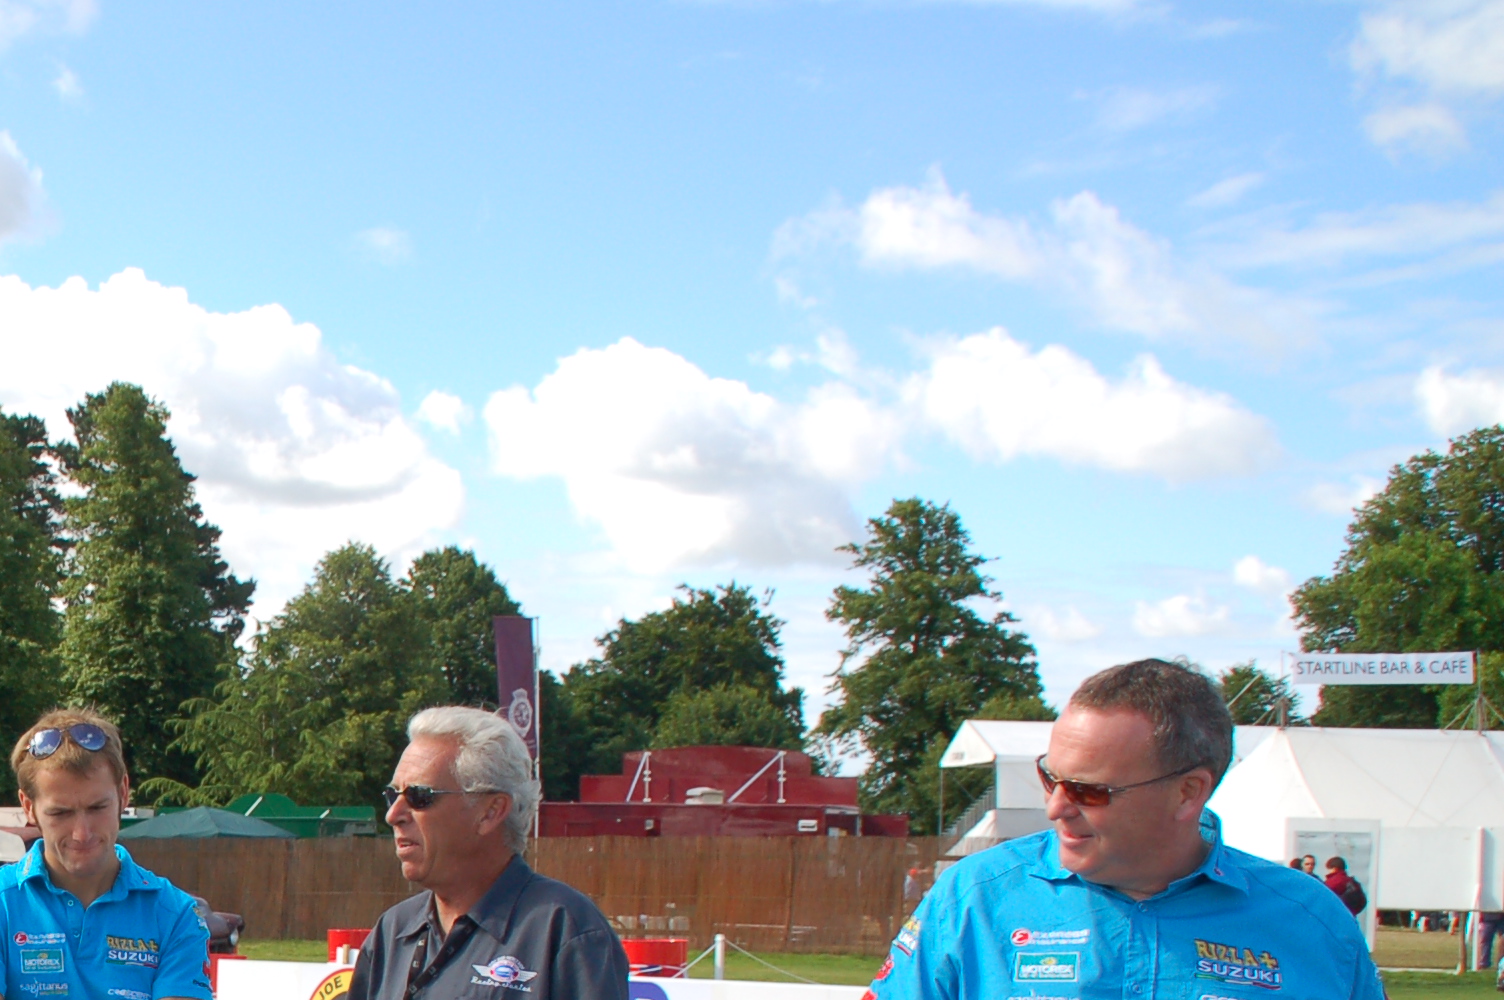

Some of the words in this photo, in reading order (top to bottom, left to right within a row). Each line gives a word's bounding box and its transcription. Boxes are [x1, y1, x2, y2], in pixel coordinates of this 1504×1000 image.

[1296, 661, 1375, 675] STARTLINE
[1380, 661, 1409, 674] BAR
[1414, 661, 1424, 674] &
[1429, 660, 1467, 674] CAFE
[108, 950, 158, 964] SUZUKI
[1198, 960, 1282, 984] SUZUKI
